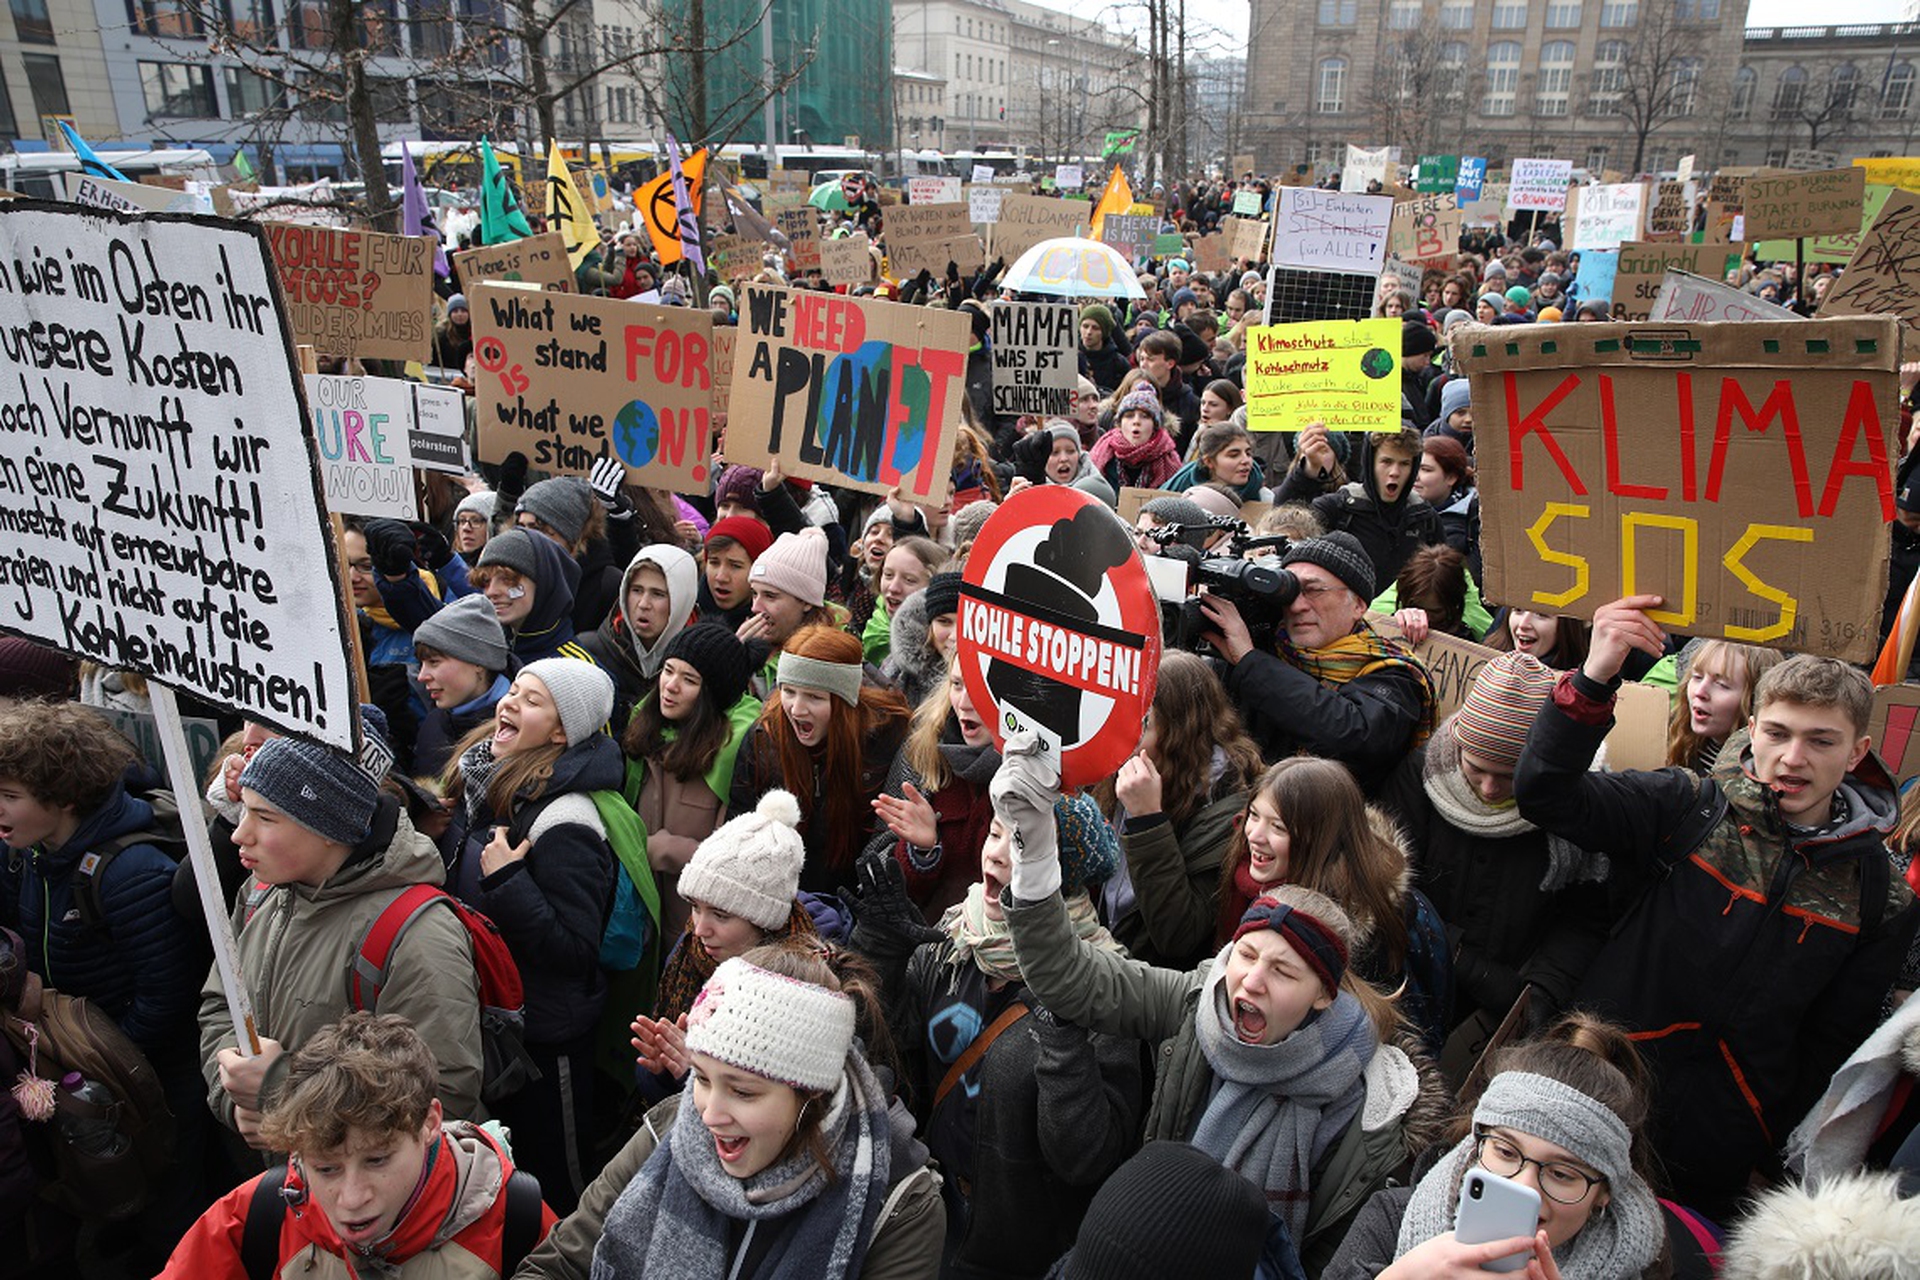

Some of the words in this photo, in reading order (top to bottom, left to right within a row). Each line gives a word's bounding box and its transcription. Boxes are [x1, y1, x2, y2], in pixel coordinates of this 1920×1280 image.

[1750, 179, 1799, 200] STOP
[1808, 184, 1843, 194] COAL
[1801, 172, 1851, 187] BURNING
[887, 210, 909, 224] WIR
[909, 208, 943, 223] WARTEN
[999, 198, 1088, 229] KOHLDAMPF
[1109, 215, 1158, 230] THERE
[1651, 206, 1691, 219] DENKT
[1750, 202, 1800, 220] START
[1807, 199, 1862, 214] BURNING
[1767, 217, 1812, 231] WEED
[895, 224, 922, 238] BLIND
[1105, 229, 1118, 242] IS
[1120, 229, 1138, 243] NO
[267, 226, 362, 270] KOHLE
[366, 234, 426, 276] FÜR
[462, 255, 508, 277] There
[506, 252, 520, 270] is
[529, 250, 551, 263] no
[1618, 247, 1700, 275] Grünkohl
[14, 245, 66, 295] wie
[66, 248, 109, 304] im
[108, 238, 213, 323] Osten
[216, 243, 270, 335] ihr
[280, 269, 382, 311] MOOS?
[363, 308, 424, 342] MUSS
[490, 297, 555, 331] What
[570, 313, 602, 335] we
[747, 286, 788, 338] WE
[793, 293, 867, 355] NEED
[992, 305, 1075, 348] MAMA
[0, 320, 114, 376] unsere
[117, 313, 244, 397] Kosten
[534, 338, 607, 373] stand
[623, 324, 712, 392] FOR
[994, 348, 1028, 370] WAS
[1033, 350, 1064, 370] IST
[1256, 332, 1337, 352] Klimaschutz
[317, 376, 369, 410] OUR
[1013, 368, 1042, 386] EIN
[1254, 378, 1294, 394] Make
[1302, 378, 1338, 390] earth
[496, 395, 560, 433] what
[569, 414, 606, 438] we
[993, 384, 1080, 417] SCHNEEMANN?
[0, 372, 48, 437] och
[43, 376, 193, 492] Vernunft
[212, 417, 271, 475] wir
[315, 407, 395, 465] URE
[748, 341, 773, 382] A
[767, 344, 965, 497] PLANET
[410, 438, 458, 455] polarstern
[534, 438, 610, 472] stand
[1502, 369, 1899, 524] KLIMA
[0, 454, 25, 495] n
[25, 446, 91, 503] eine
[92, 453, 267, 556] Zukunft!
[327, 464, 413, 520] NOW!
[72, 505, 111, 572] auf
[1524, 501, 1815, 643] SOS
[59, 551, 103, 600] und
[108, 566, 166, 617] nicht
[172, 586, 218, 658] auf
[220, 593, 274, 652] die
[962, 598, 1024, 659] KOHLE
[1028, 620, 1142, 697] STOPPEN!
